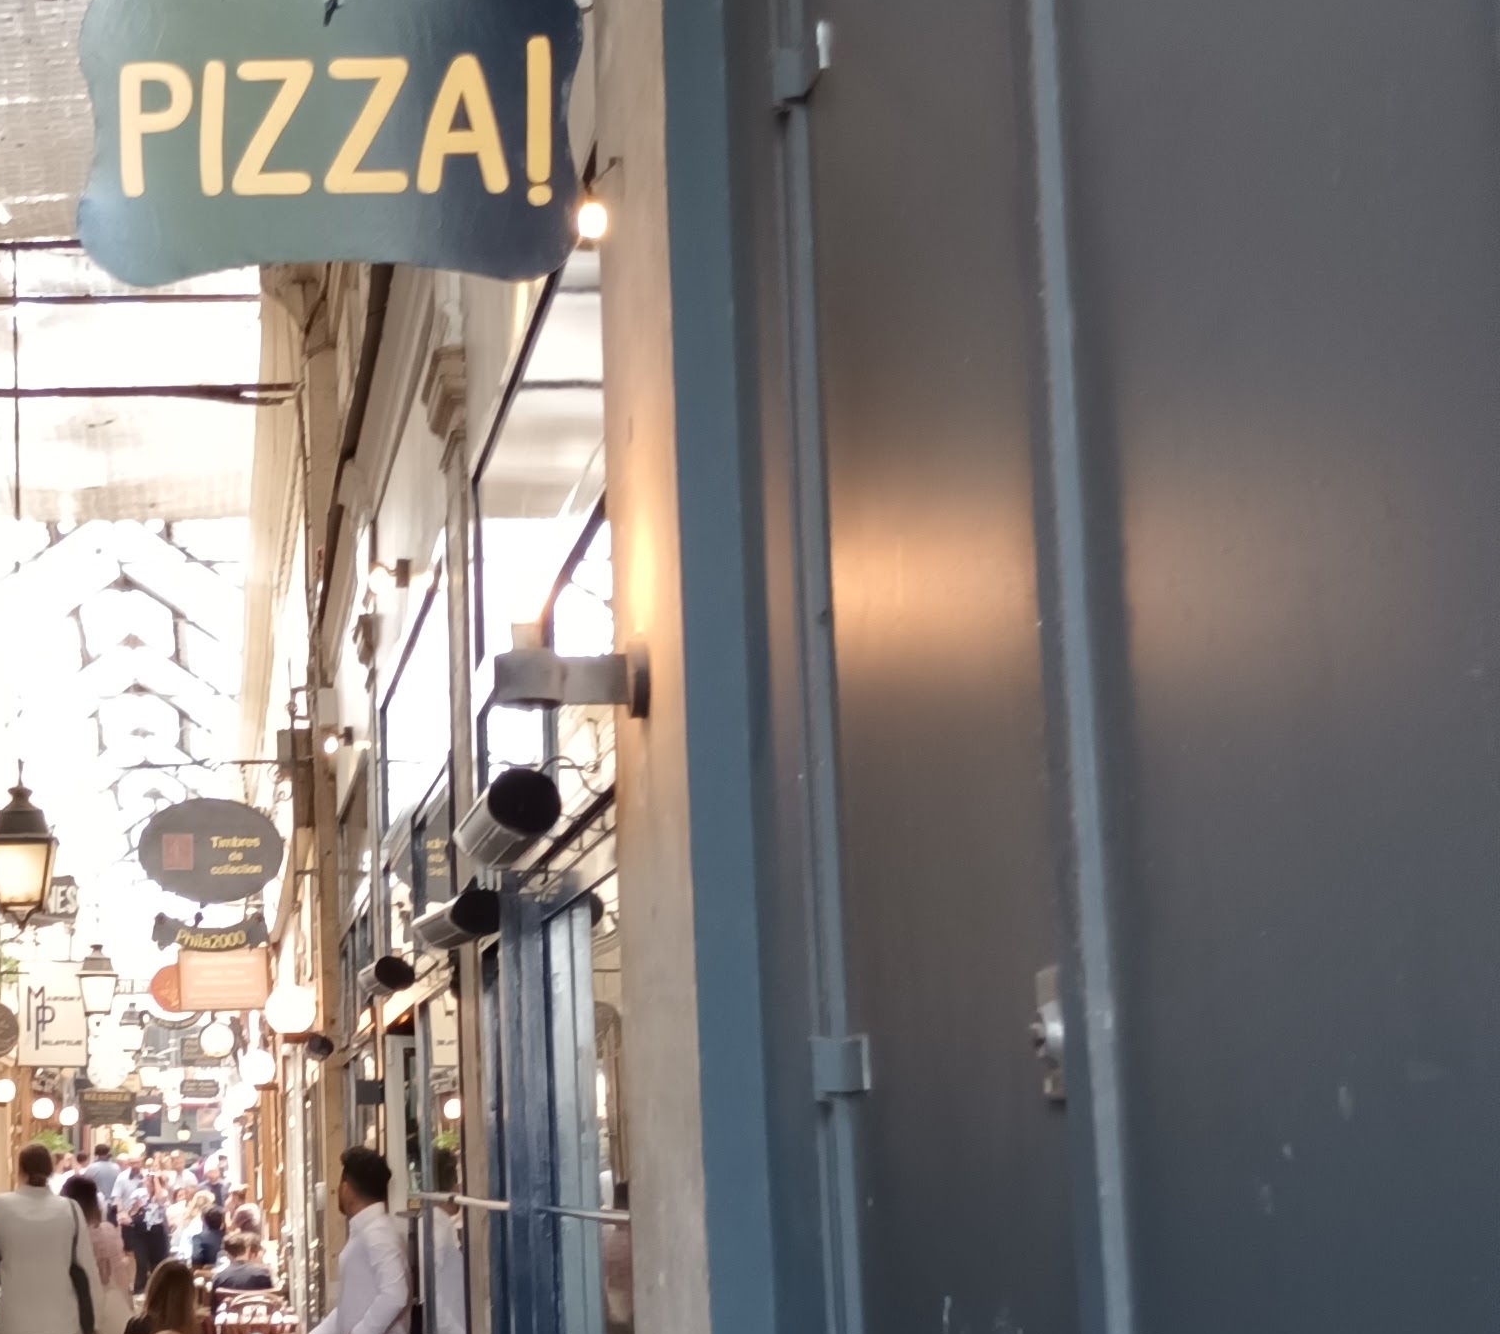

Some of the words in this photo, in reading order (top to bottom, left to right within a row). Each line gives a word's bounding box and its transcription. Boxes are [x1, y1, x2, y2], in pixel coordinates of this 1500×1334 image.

[117, 34, 554, 207] PIZZA!
[209, 835, 262, 849] Timbres
[227, 850, 244, 862] de
[209, 863, 263, 875] collection
[174, 928, 247, 950] Phila2000
